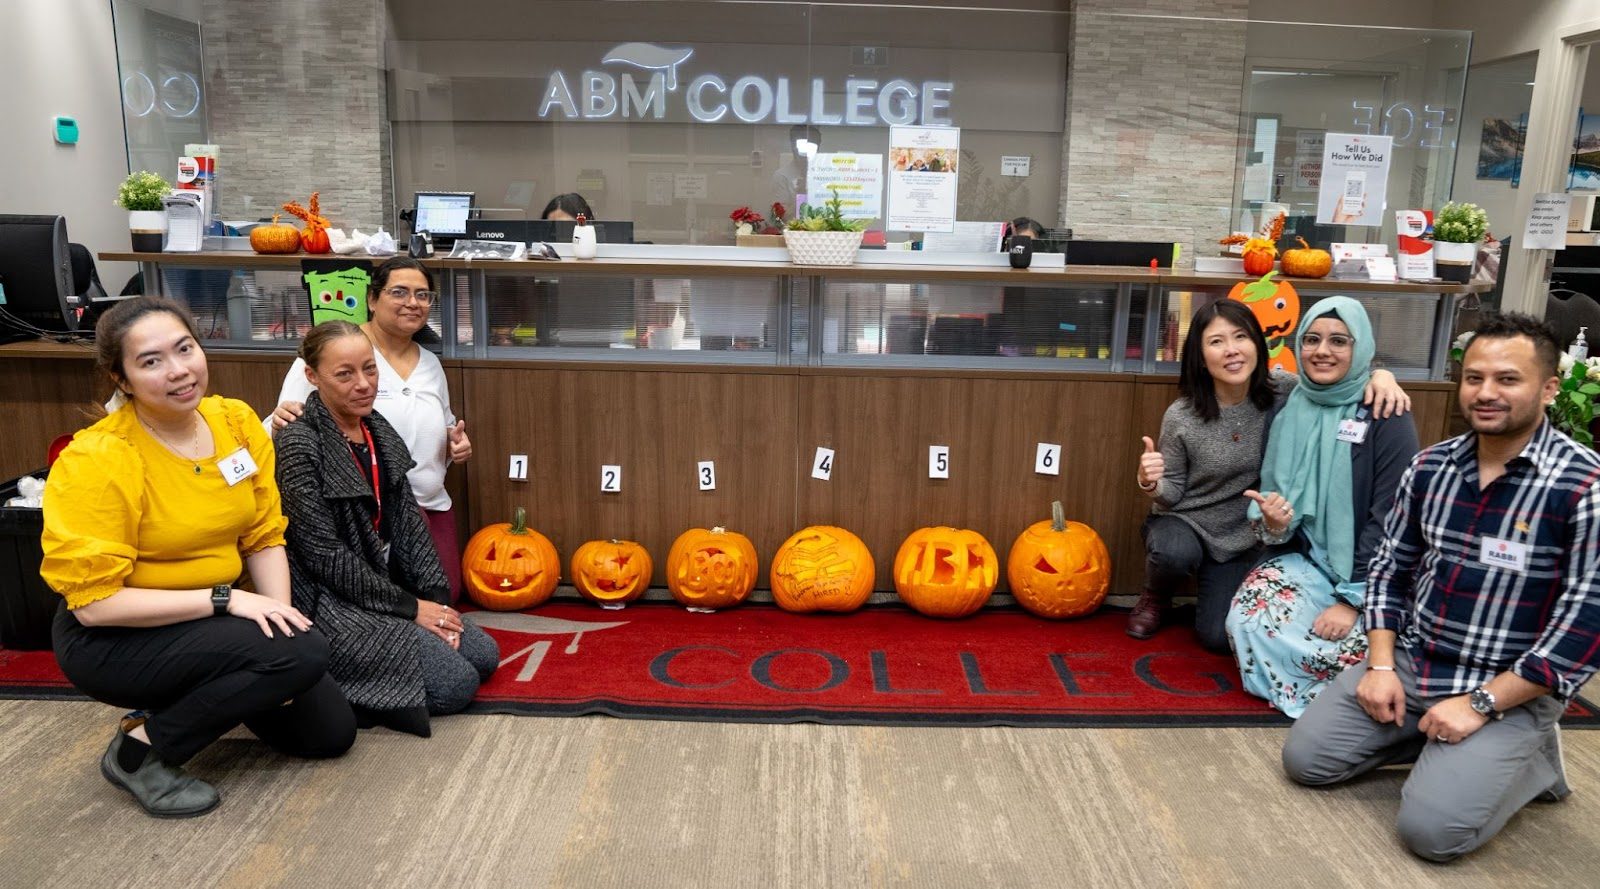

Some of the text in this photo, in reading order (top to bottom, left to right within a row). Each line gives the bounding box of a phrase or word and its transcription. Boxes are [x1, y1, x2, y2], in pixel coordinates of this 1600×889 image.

[537, 69, 954, 126] ABM COLLEGE
[1331, 152, 1383, 162] How We Did
[1345, 145, 1359, 153] Tell
[476, 230, 505, 239] Lenovo
[818, 454, 831, 474] 4
[936, 452, 947, 472] 5
[1042, 448, 1053, 468] 6
[233, 463, 245, 474] CJ
[515, 460, 523, 478] 1
[701, 467, 712, 486] 3
[604, 470, 615, 490] 2
[1488, 550, 1517, 562] RABBI
[649, 644, 1235, 697] COLLEG
